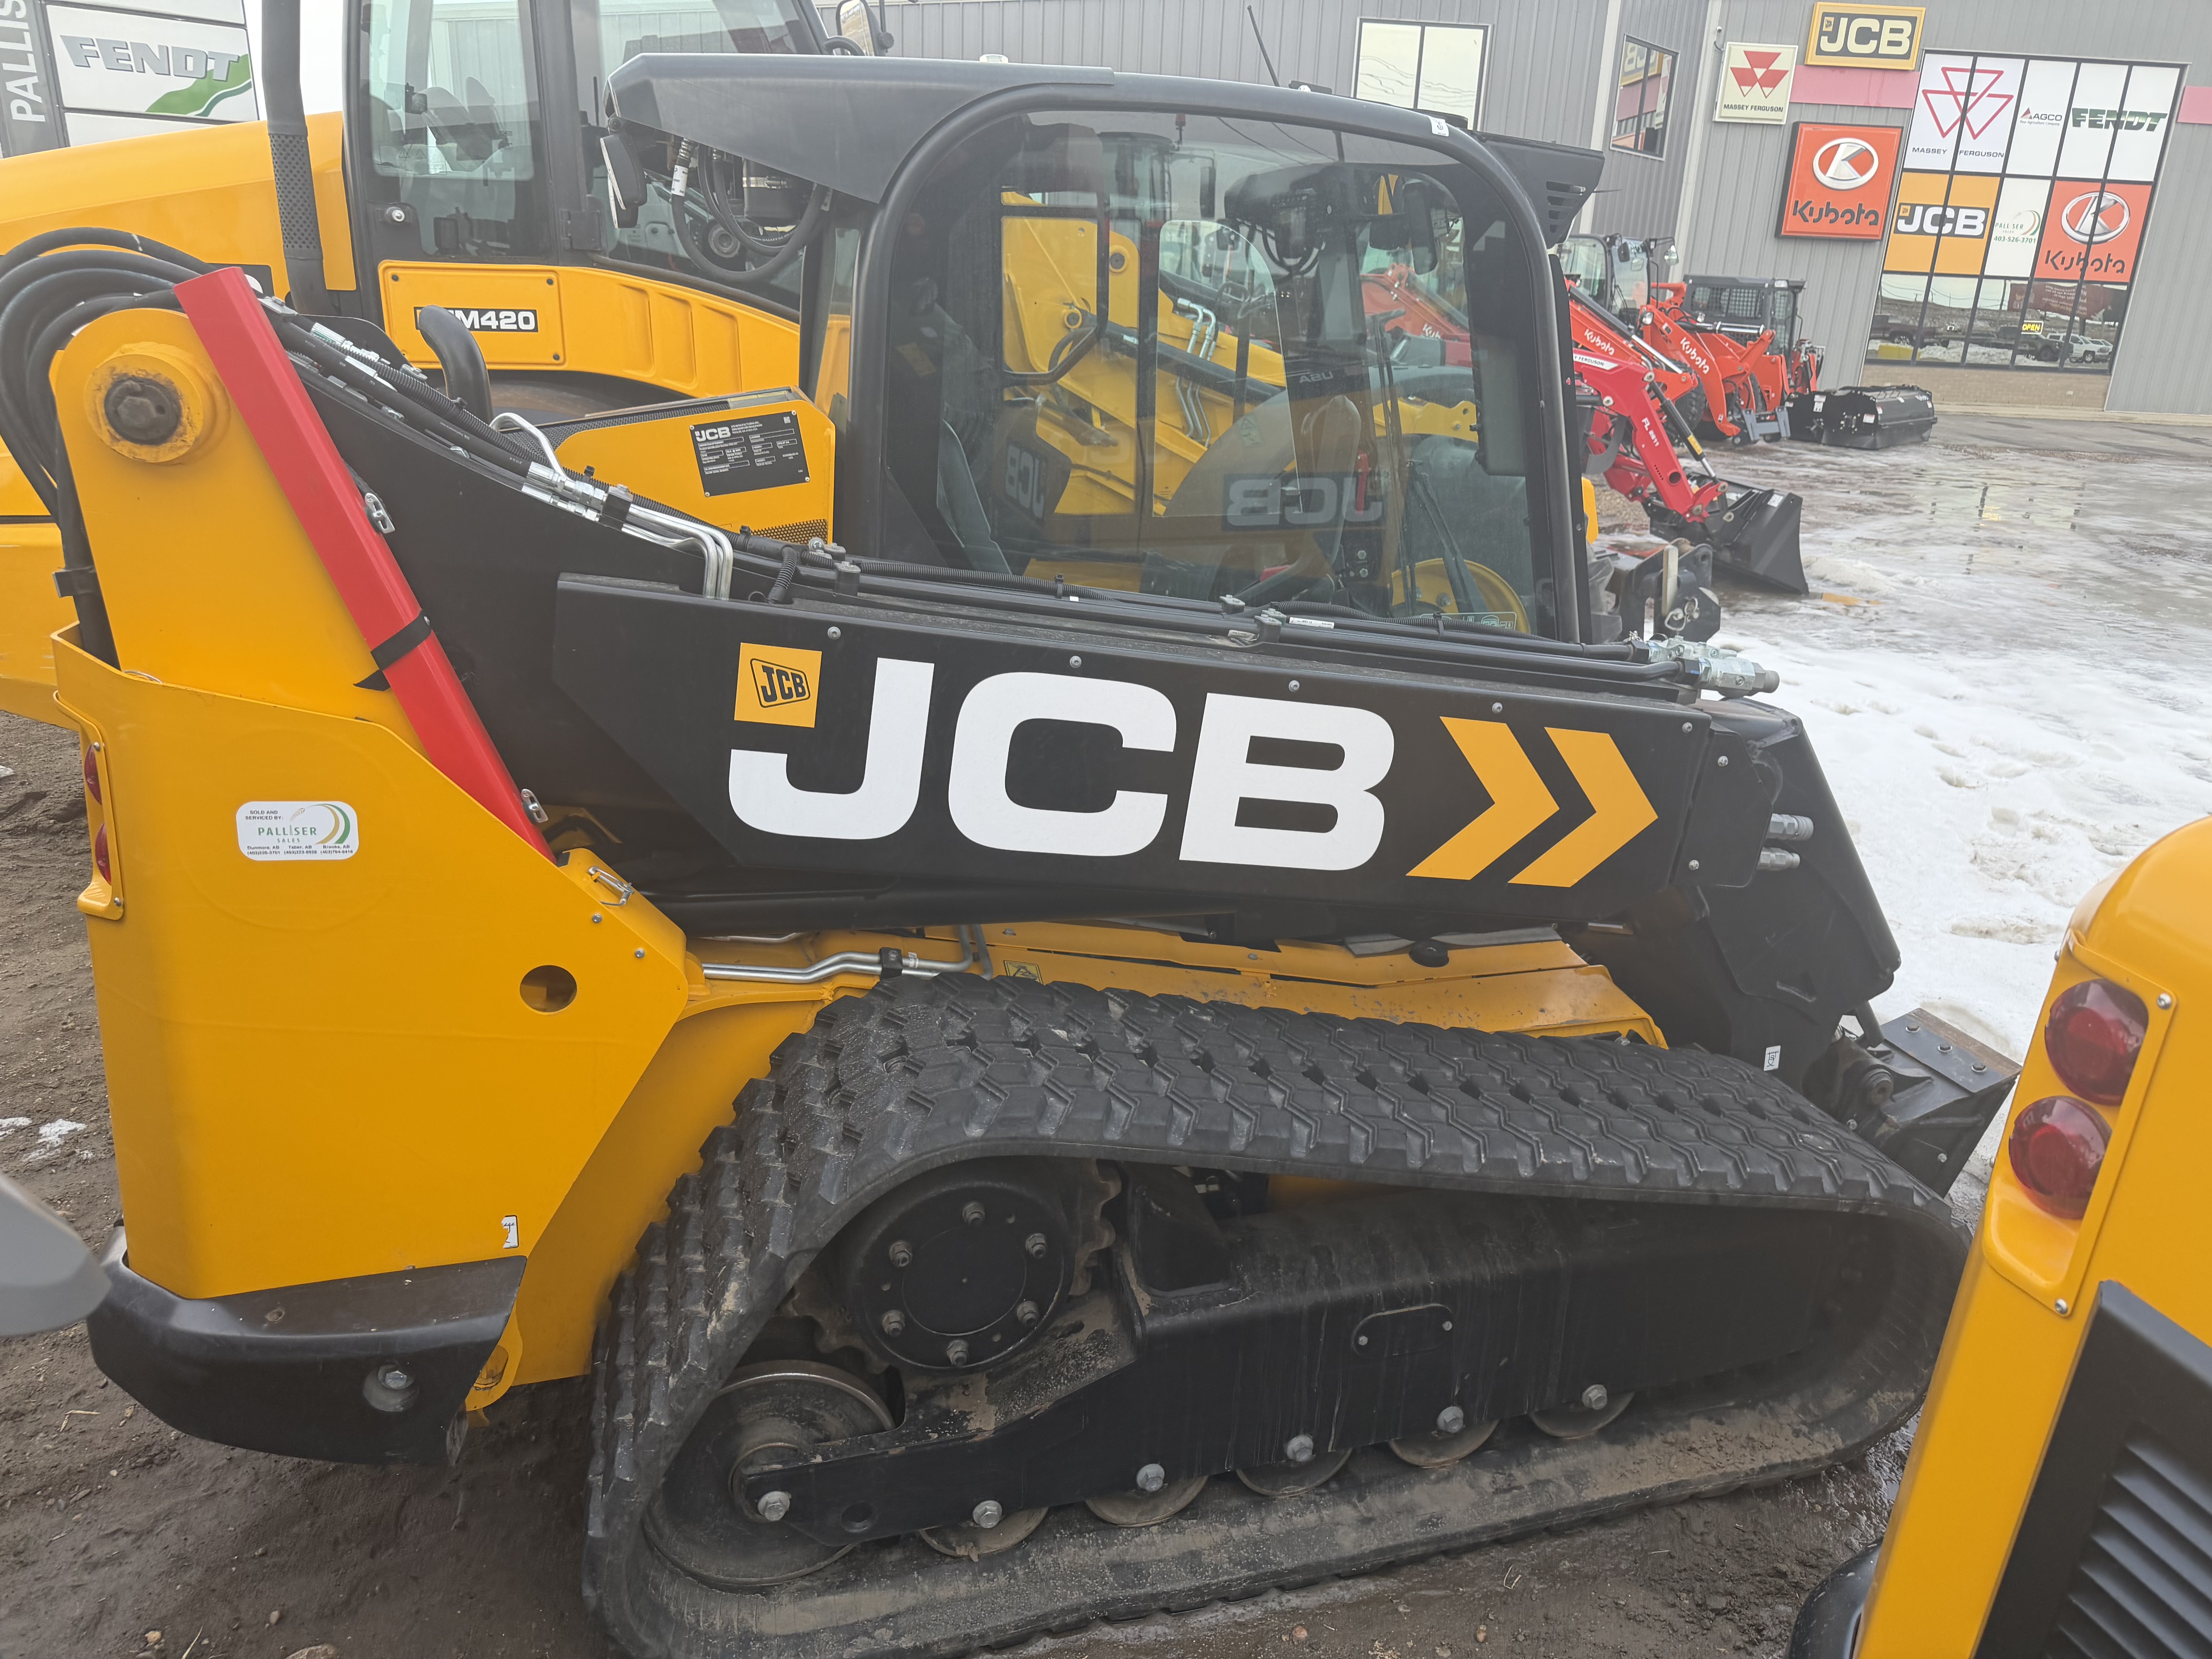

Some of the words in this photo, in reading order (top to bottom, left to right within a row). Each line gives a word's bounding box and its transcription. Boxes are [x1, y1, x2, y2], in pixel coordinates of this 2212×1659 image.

[1820, 17, 1912, 55] JCB
[60, 34, 240, 82] FENDT
[2033, 113, 2063, 121] AGCO
[2072, 107, 2168, 132] FENDT
[1959, 150, 2004, 158] FERGUSON
[1793, 200, 1879, 225] Kubota
[1897, 206, 1985, 235] JCB
[1994, 235, 2036, 244] 403-526-3701
[2045, 250, 2125, 273] Kubota
[448, 310, 536, 330] M420
[1423, 323, 1441, 339] Kub
[1584, 329, 1615, 356] Kubota
[1578, 356, 1604, 366] FERGUSON
[1680, 337, 1710, 374] Kubota
[696, 426, 731, 442] JCB
[760, 664, 807, 703] JCB
[728, 657, 1395, 871] JCB
[258, 825, 317, 836] PALLISER
